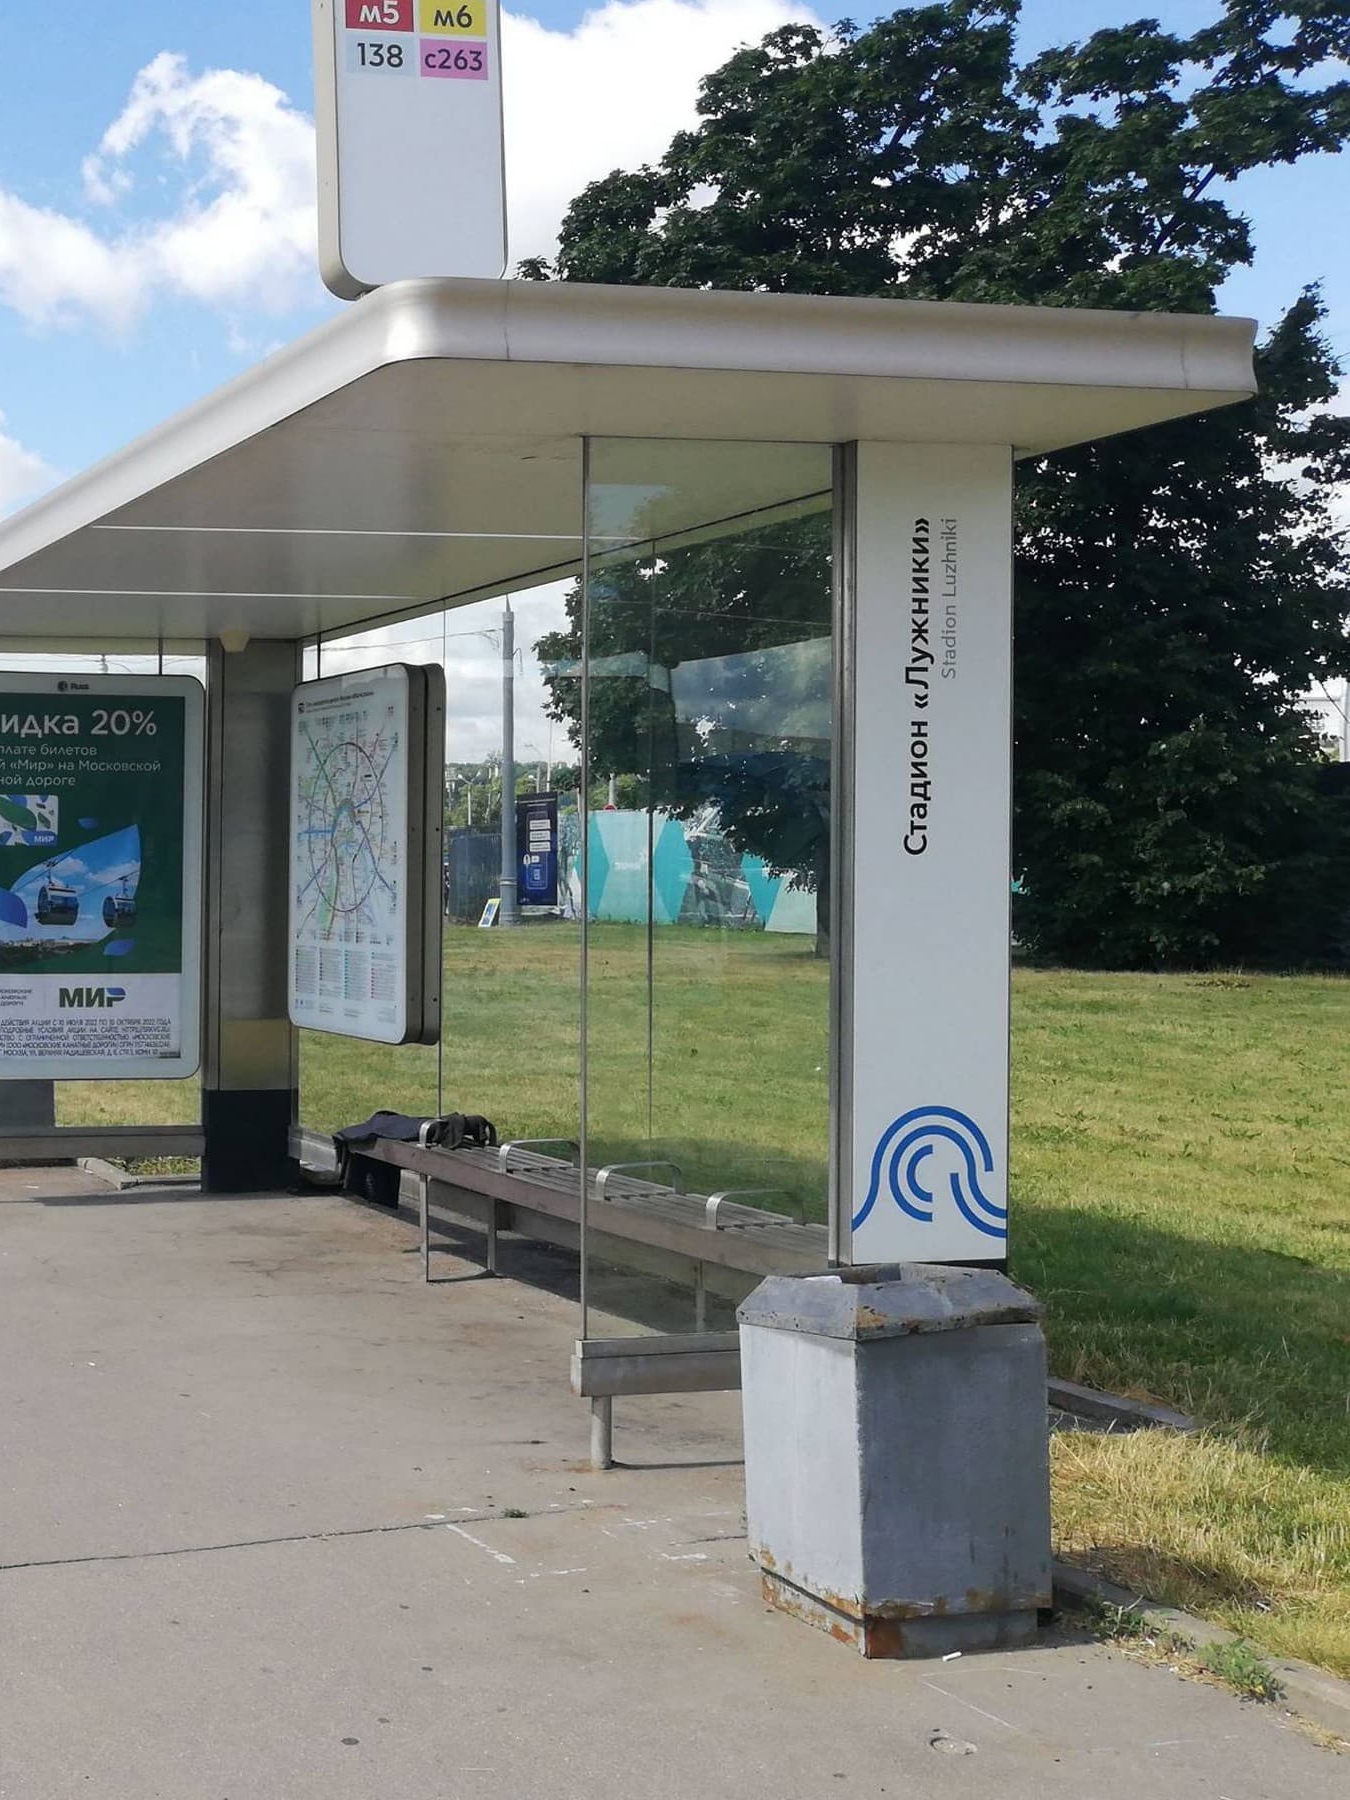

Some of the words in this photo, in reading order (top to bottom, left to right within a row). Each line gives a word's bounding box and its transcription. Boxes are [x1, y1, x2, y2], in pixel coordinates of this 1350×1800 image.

[357, 42, 404, 68] 138
[940, 517, 957, 597] Luzhniki
[904, 517, 934, 710] «Лужники»
[941, 605, 957, 680] Stadion
[91, 709, 158, 736] 20%
[40, 744, 98, 756] билетов
[10, 759, 55, 773] «Мир»
[58, 762, 75, 771] на
[78, 758, 161, 772] Московской
[25, 776, 76, 788] дороге
[903, 720, 931, 856] Стадион
[58, 987, 127, 1008] МИР
